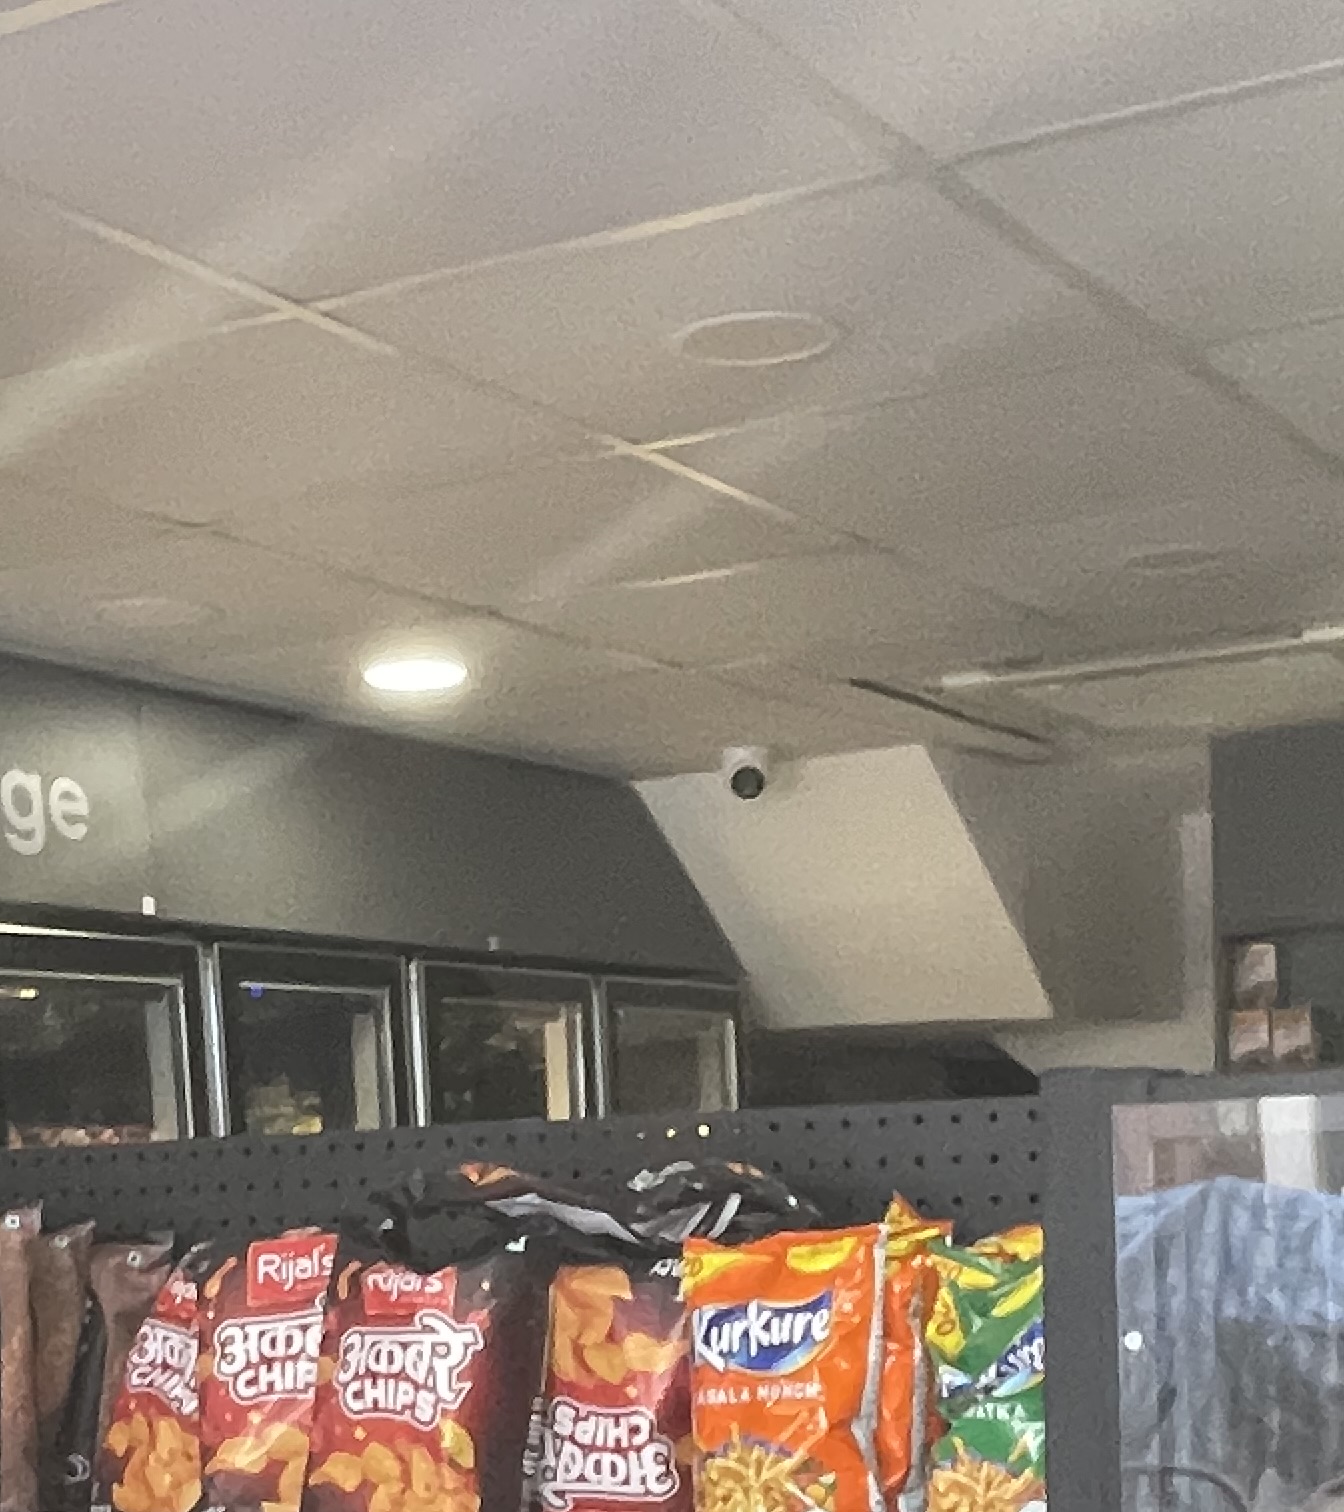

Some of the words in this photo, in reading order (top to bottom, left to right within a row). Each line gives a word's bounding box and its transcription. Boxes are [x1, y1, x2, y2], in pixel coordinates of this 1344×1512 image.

[692, 1299, 831, 1372] Kurkure
[345, 1377, 435, 1422] CHIPS
[553, 1406, 651, 1450] CHIPS
